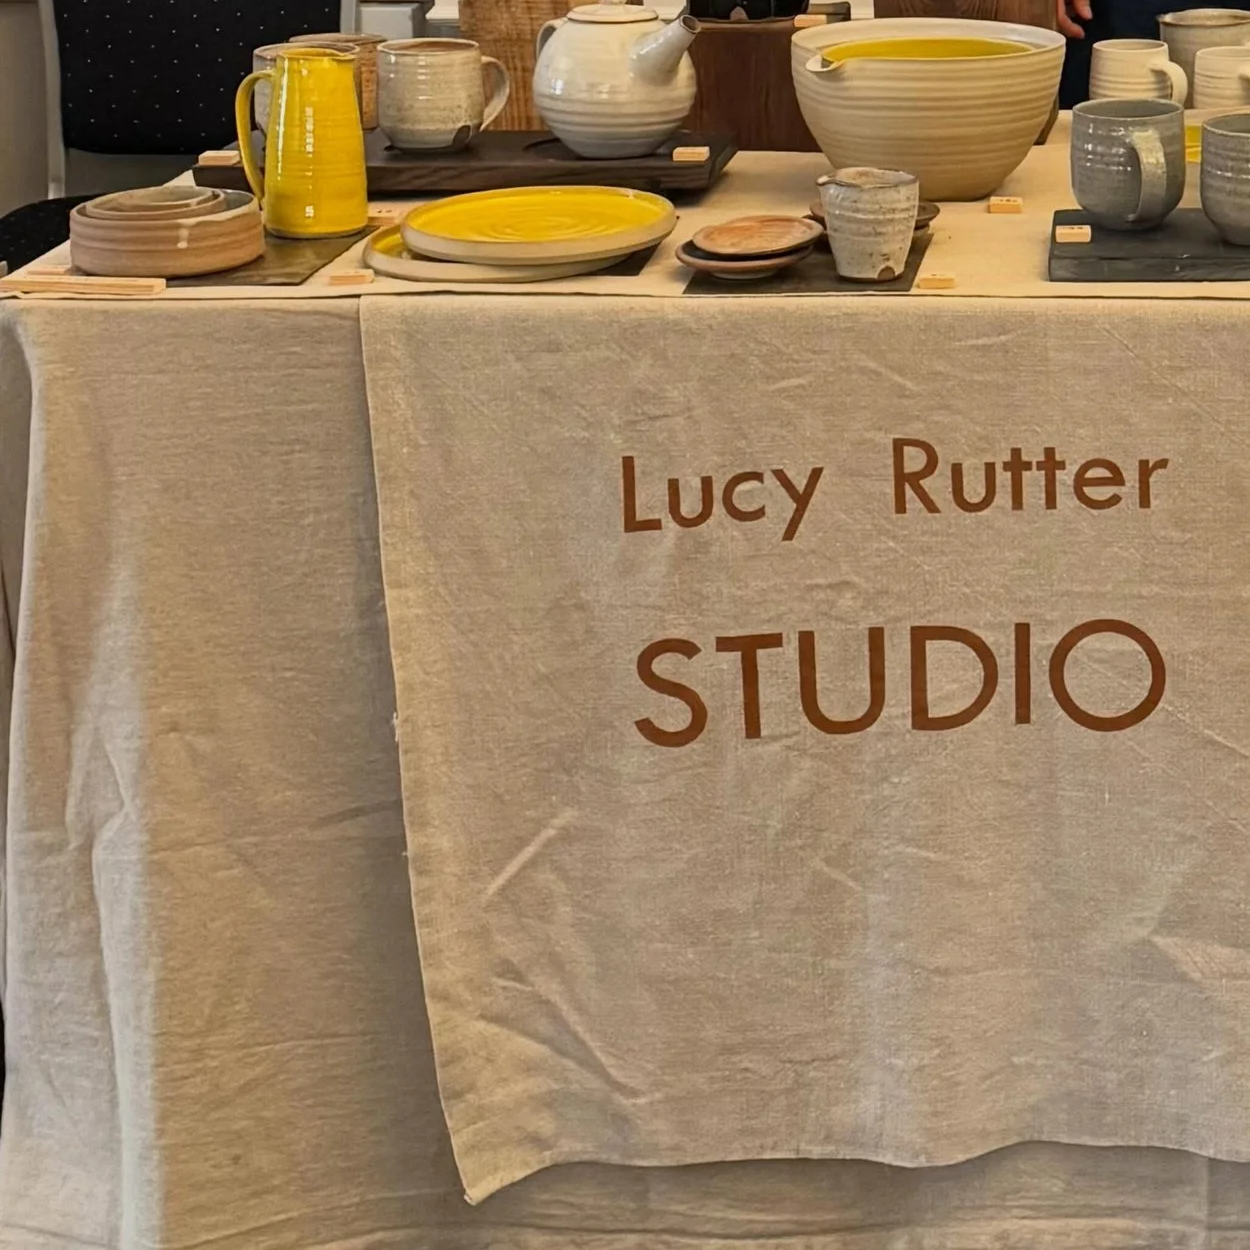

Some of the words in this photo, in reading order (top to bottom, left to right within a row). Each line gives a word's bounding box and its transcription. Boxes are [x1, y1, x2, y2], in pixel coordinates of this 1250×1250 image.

[621, 455, 825, 542] Lucy
[892, 437, 1170, 515] Rutter
[633, 618, 1167, 749] STUDIO
